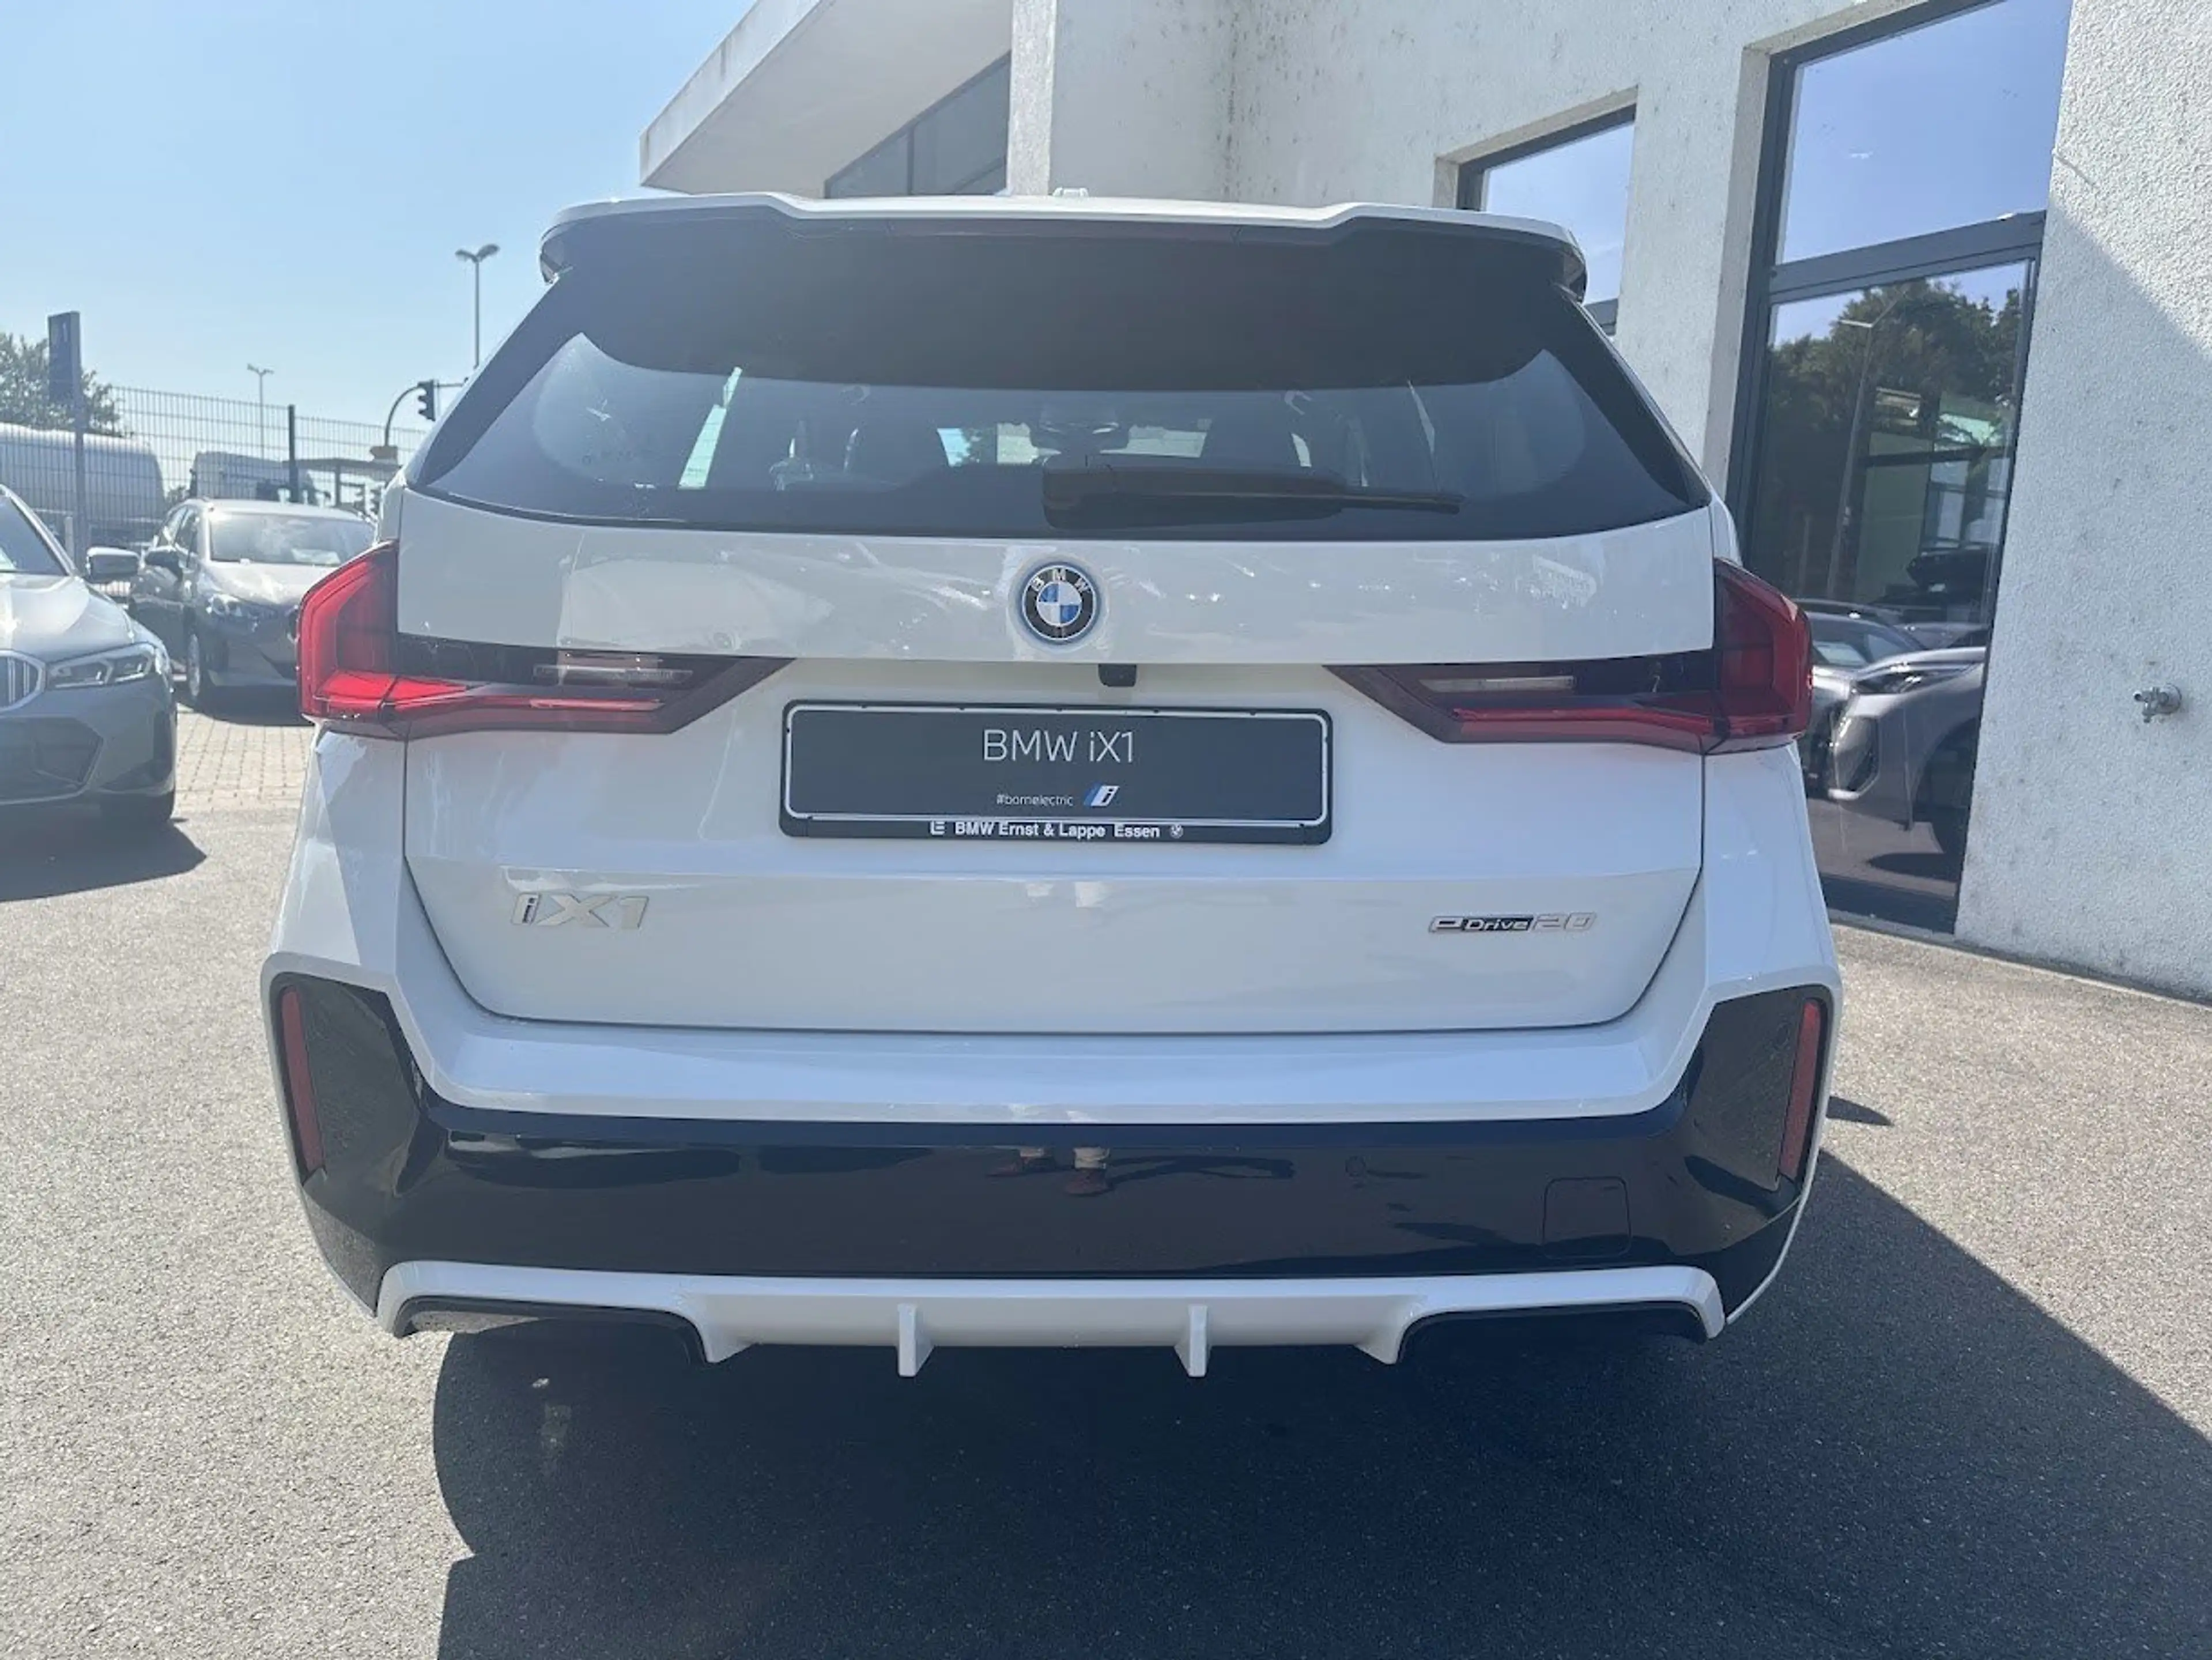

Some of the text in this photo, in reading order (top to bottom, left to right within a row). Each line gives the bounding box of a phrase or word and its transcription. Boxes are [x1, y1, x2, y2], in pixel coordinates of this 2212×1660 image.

[983, 729, 1134, 763] BMW iX1
[955, 821, 994, 836] BMW
[998, 821, 1039, 836] Ernst
[1043, 823, 1054, 836] &
[1113, 824, 1160, 837] Essen
[511, 893, 649, 929] iX1
